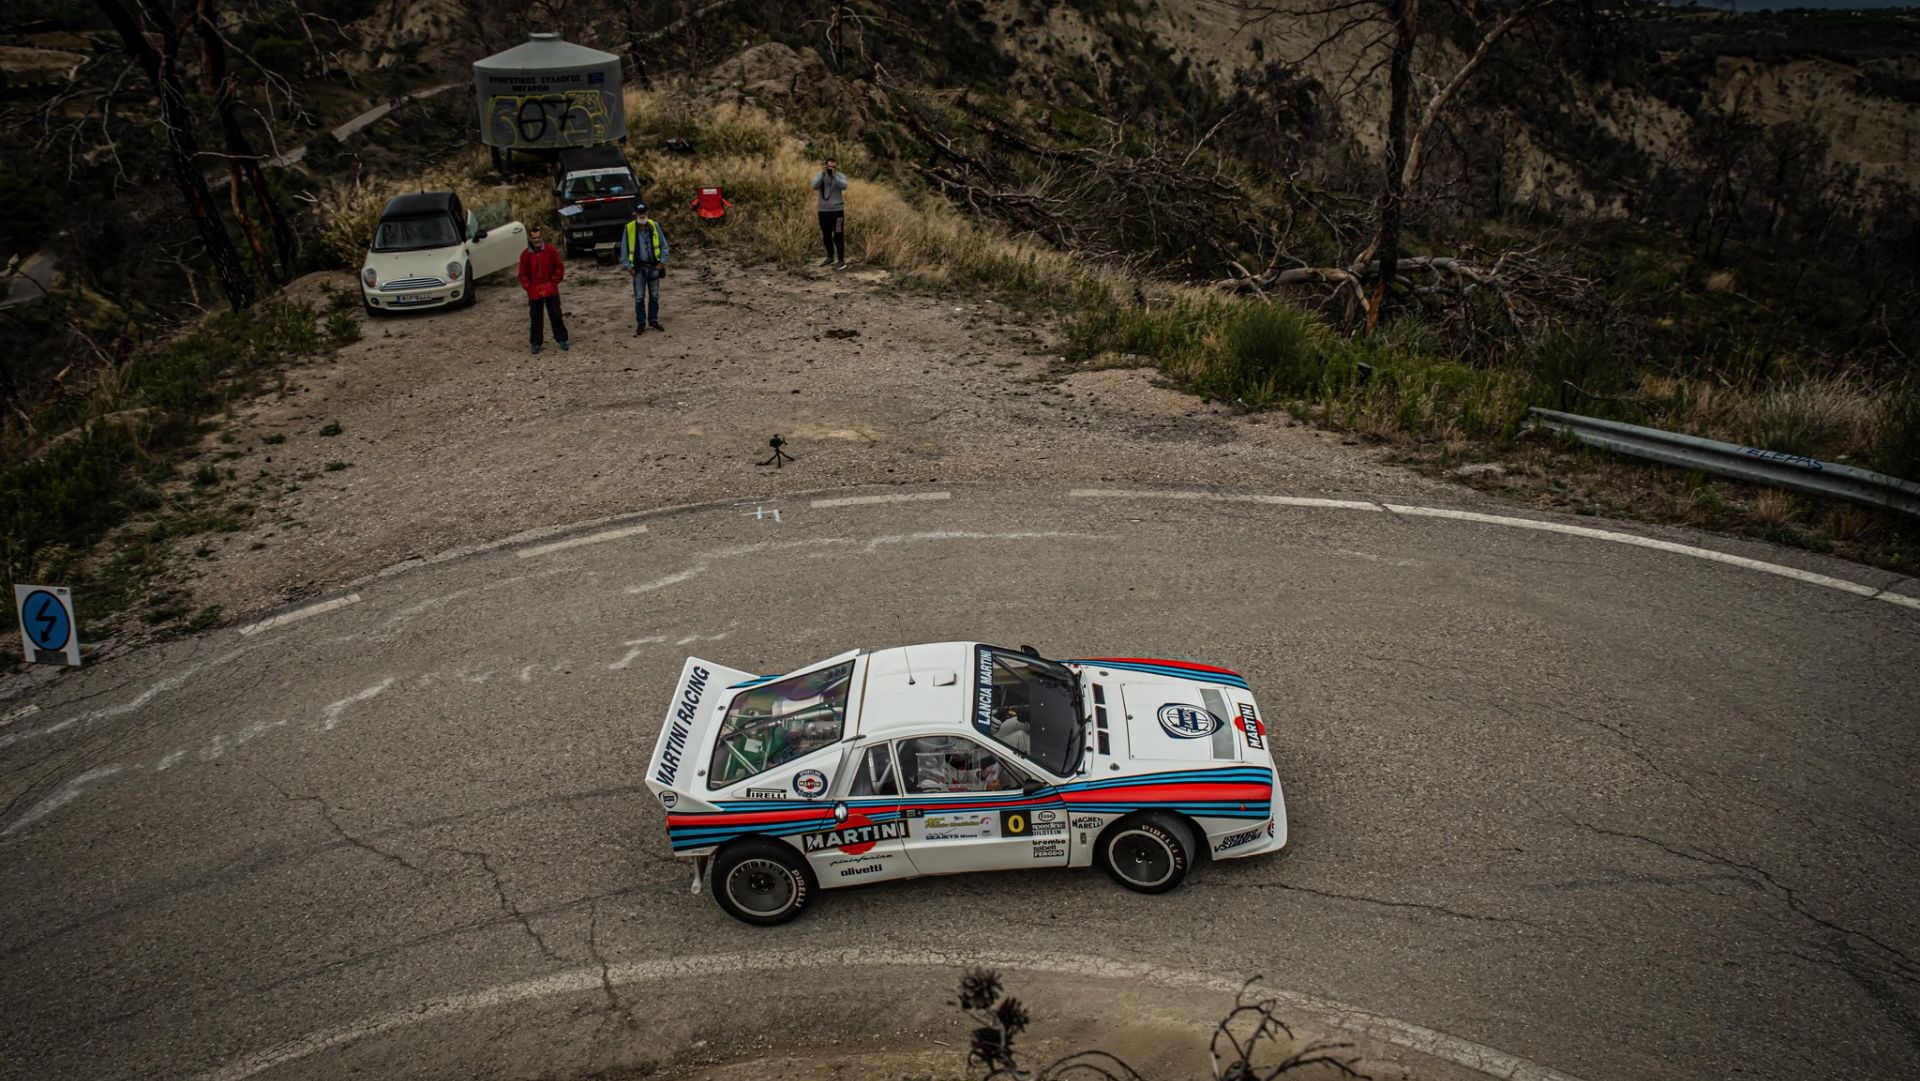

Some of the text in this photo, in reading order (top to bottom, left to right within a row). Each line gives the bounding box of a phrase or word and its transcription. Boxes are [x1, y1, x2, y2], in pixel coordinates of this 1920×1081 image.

[677, 665, 710, 726] RACING
[978, 649, 992, 726] LANCIA MARTINI
[1240, 704, 1262, 749] MARTINI
[746, 788, 787, 799] PIRELLI
[806, 822, 906, 850] MARTINI
[1008, 814, 1025, 833] 0
[1142, 824, 1179, 854] PIRELLI
[840, 864, 883, 877] olivetti
[791, 869, 806, 908] PIRELLI
